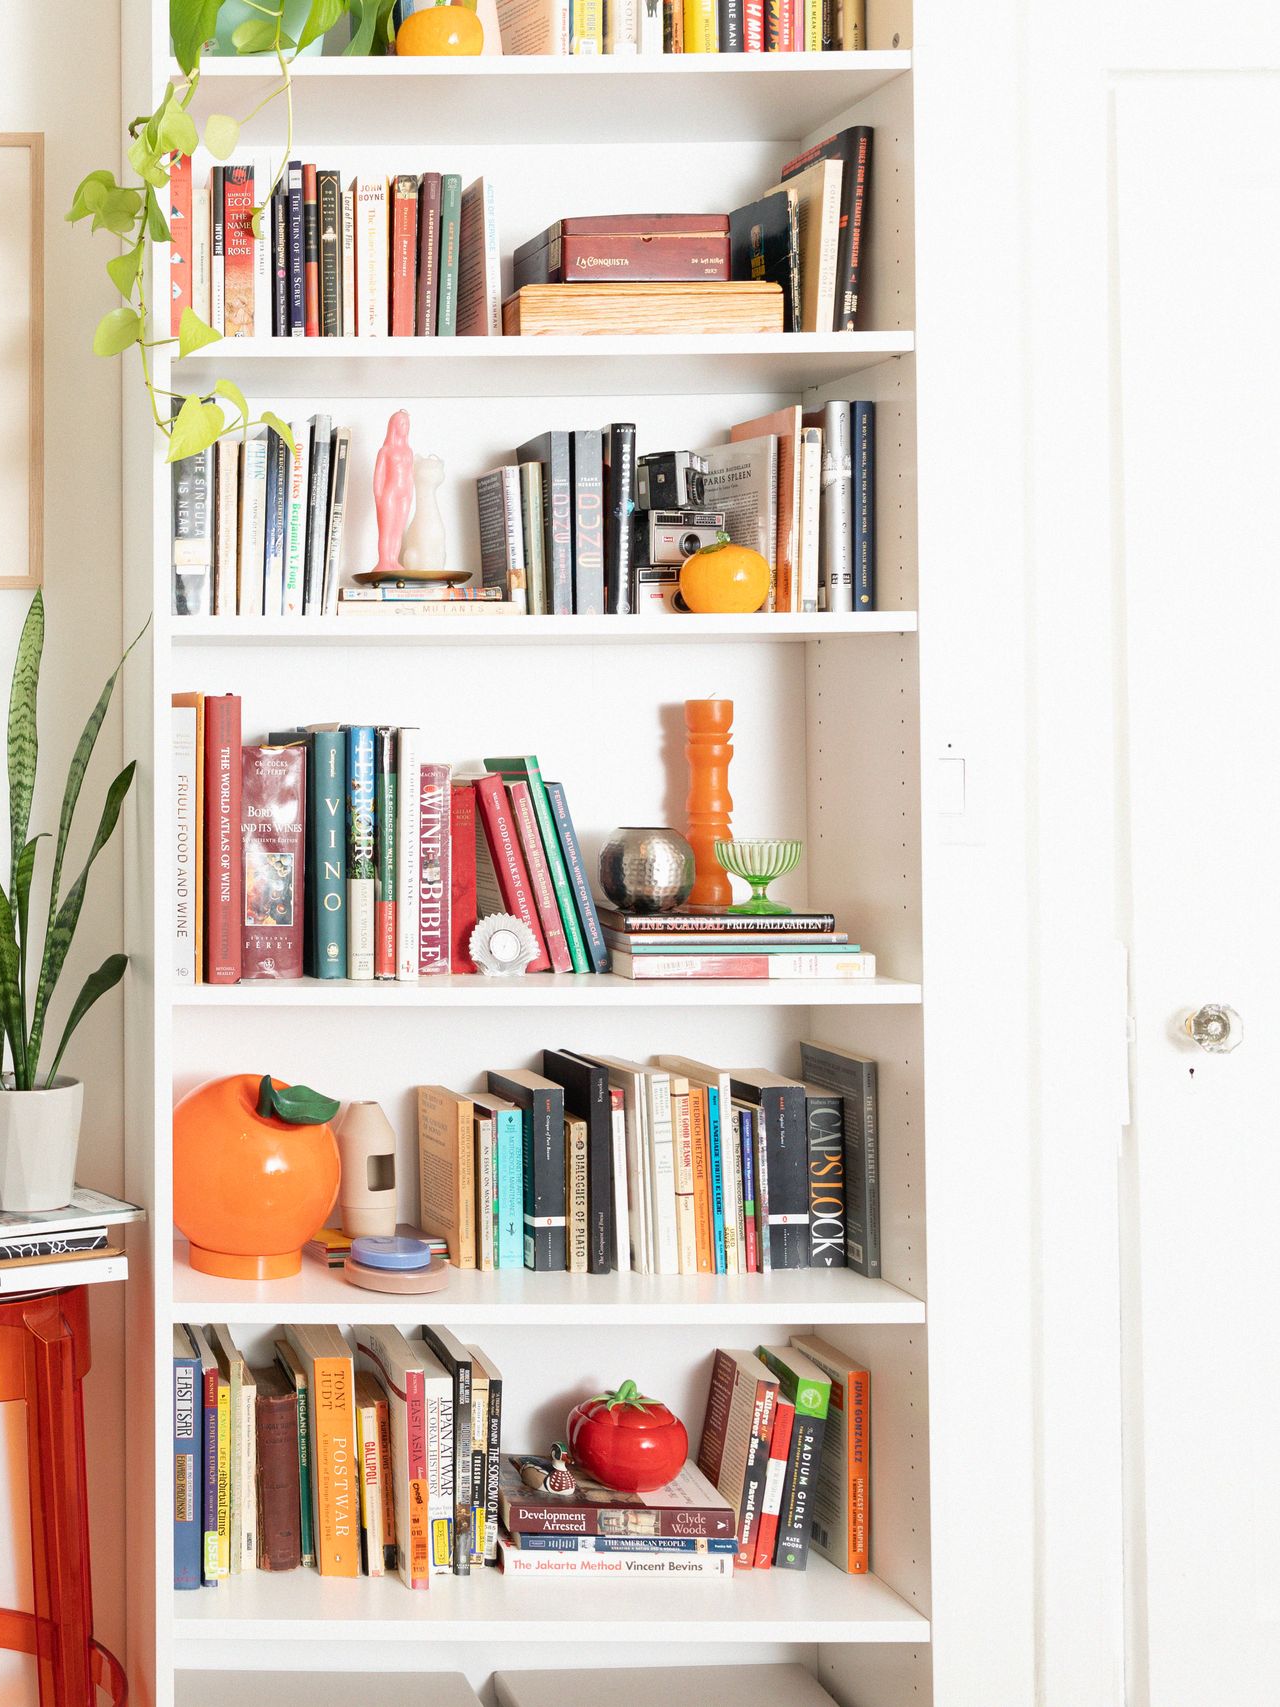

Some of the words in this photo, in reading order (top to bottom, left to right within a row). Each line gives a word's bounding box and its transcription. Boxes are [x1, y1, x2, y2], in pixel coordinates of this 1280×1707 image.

[858, 137, 868, 164] STORIES
[359, 183, 383, 192] JOHN
[857, 165, 866, 183] FROM
[227, 198, 252, 207] ECO
[358, 193, 385, 202] BOYNE
[856, 184, 865, 197] THE
[227, 222, 252, 230] NAME
[854, 198, 864, 227] TENANTS
[214, 223, 224, 240] INTO
[214, 241, 224, 256] THE
[227, 247, 252, 256] ROSE
[851, 227, 862, 268] DOWNSTAIRS
[844, 290, 854, 315] FOFANA
[851, 294, 859, 312] SIDIK
[180, 482, 189, 494] IS
[703, 475, 726, 487] PARIS
[727, 470, 753, 483] SPLEEN
[180, 500, 189, 537] NEAR
[221, 747, 230, 771] THE
[176, 774, 189, 822] FRIULI
[221, 773, 230, 813] WORLD
[355, 740, 375, 861] TERROIR
[554, 790, 566, 819] FEIRING
[221, 816, 230, 850] ATLAS
[421, 786, 444, 857] WINE
[518, 797, 537, 848] Understanding
[176, 826, 188, 865] FOOD
[324, 798, 342, 912] VINO
[388, 835, 394, 847] OF
[564, 831, 581, 867] NATURAL
[221, 852, 230, 869] OF
[529, 848, 542, 869] Wine
[176, 868, 188, 898] AND
[221, 871, 230, 902] WINE
[533, 868, 552, 909] Technology
[573, 866, 585, 886] WINE
[579, 886, 589, 902] FOR
[176, 902, 188, 938] WINE
[420, 882, 443, 963] BIBLE
[582, 901, 592, 918] THE
[631, 916, 667, 931] WINE
[667, 916, 724, 931] SCANDAL
[726, 918, 756, 930] FRITZ
[756, 918, 822, 930] HALLGARTEN
[387, 924, 393, 934] TO
[587, 917, 601, 947] PEOPLE
[245, 940, 293, 949] FÉRET
[484, 1146, 490, 1156] AN
[809, 1108, 844, 1176] CAPS
[484, 1176, 490, 1186] ON
[575, 1154, 585, 1207] DIALOGUES
[575, 1210, 585, 1223] OF
[810, 1181, 845, 1257] LOCK
[576, 1228, 586, 1258] PLATO
[176, 1375, 192, 1404] LAST
[321, 1370, 332, 1410] JUDT
[334, 1370, 345, 1411] TONY
[176, 1406, 193, 1436] TSAR
[410, 1399, 421, 1432] EAST
[429, 1398, 438, 1416] AN
[440, 1397, 453, 1442] JAPAN
[751, 1400, 763, 1437] Flower
[762, 1390, 774, 1426] Killers
[429, 1418, 439, 1447] ORAL
[412, 1433, 422, 1462] ASIA
[440, 1443, 453, 1462] AT
[748, 1437, 759, 1467] Moon
[799, 1435, 814, 1485] RADIUM
[176, 1455, 186, 1483] EDWARD
[364, 1441, 377, 1486] GALLIPOLI
[429, 1451, 439, 1497] HISTORY
[332, 1437, 350, 1537] POSTWAR
[440, 1464, 453, 1497] WAR
[176, 1483, 187, 1520] RADZINSKY
[746, 1481, 759, 1511] David
[793, 1491, 807, 1530] GIRLS
[519, 1509, 586, 1524] Development
[543, 1520, 586, 1532] Arrested
[671, 1523, 707, 1535] Woods
[676, 1512, 706, 1525] Clyde
[742, 1511, 754, 1545] Grann
[782, 1541, 803, 1549] MOORE
[513, 1560, 532, 1570] The
[533, 1560, 577, 1571] Jakarta
[580, 1560, 622, 1571] Method
[625, 1560, 666, 1572] Vincent
[668, 1560, 703, 1572] Bevins
